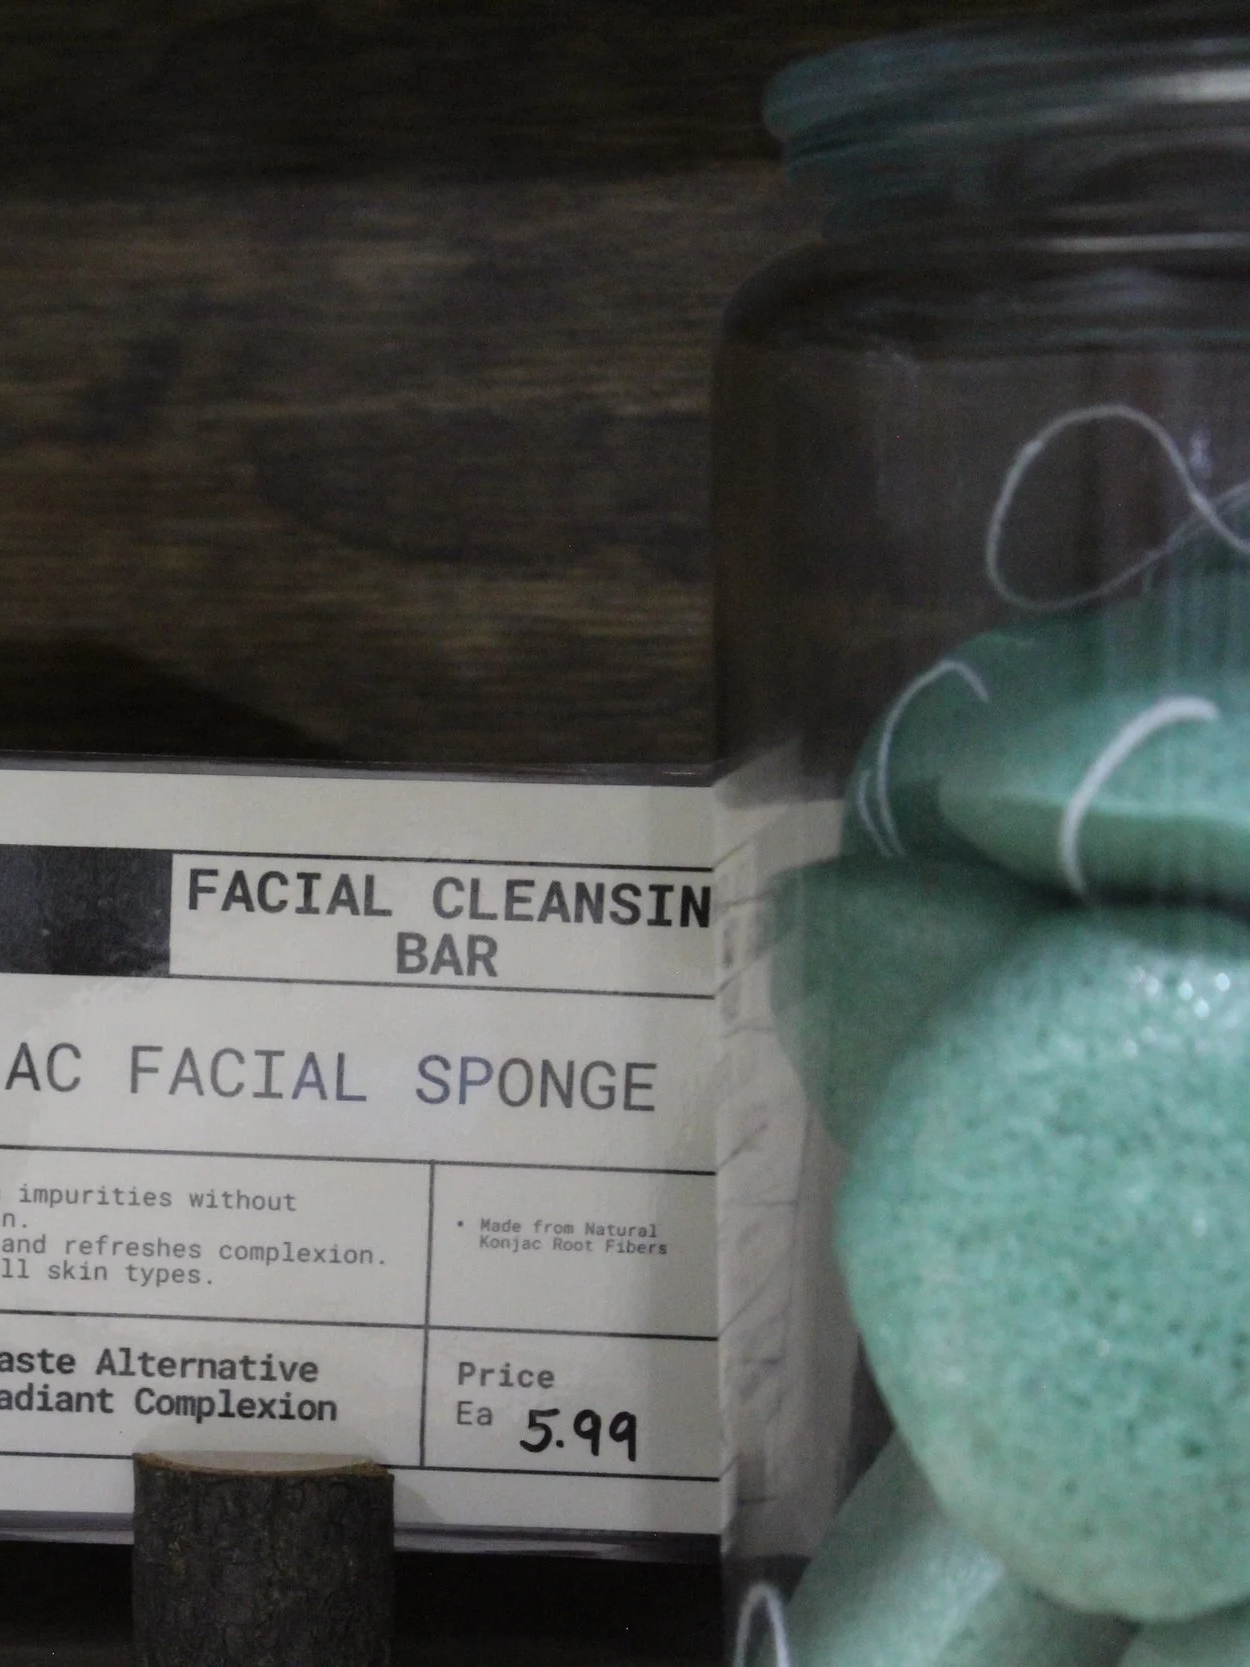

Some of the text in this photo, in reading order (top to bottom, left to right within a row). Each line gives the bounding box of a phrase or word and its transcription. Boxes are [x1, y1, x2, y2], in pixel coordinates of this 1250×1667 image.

[188, 868, 711, 928] FACIAL CLEANSIN
[396, 932, 498, 977] BAR
[130, 1045, 367, 1102] FACIAL
[415, 1055, 658, 1112] SPONGE
[19, 1183, 172, 1208] impurities
[189, 1189, 297, 1212] without
[480, 1219, 657, 1238] Made from Natural
[1, 1235, 46, 1254] and
[65, 1236, 202, 1259] refreshes
[219, 1242, 386, 1266] complexion.
[480, 1236, 668, 1255] Konjac Root Fibers
[47, 1261, 108, 1281] skin
[126, 1265, 214, 1287] types.
[95, 1348, 319, 1383] Alternative
[457, 1361, 556, 1389] Price
[135, 1388, 337, 1424] Complexion
[456, 1401, 637, 1462] Ea 5.99
